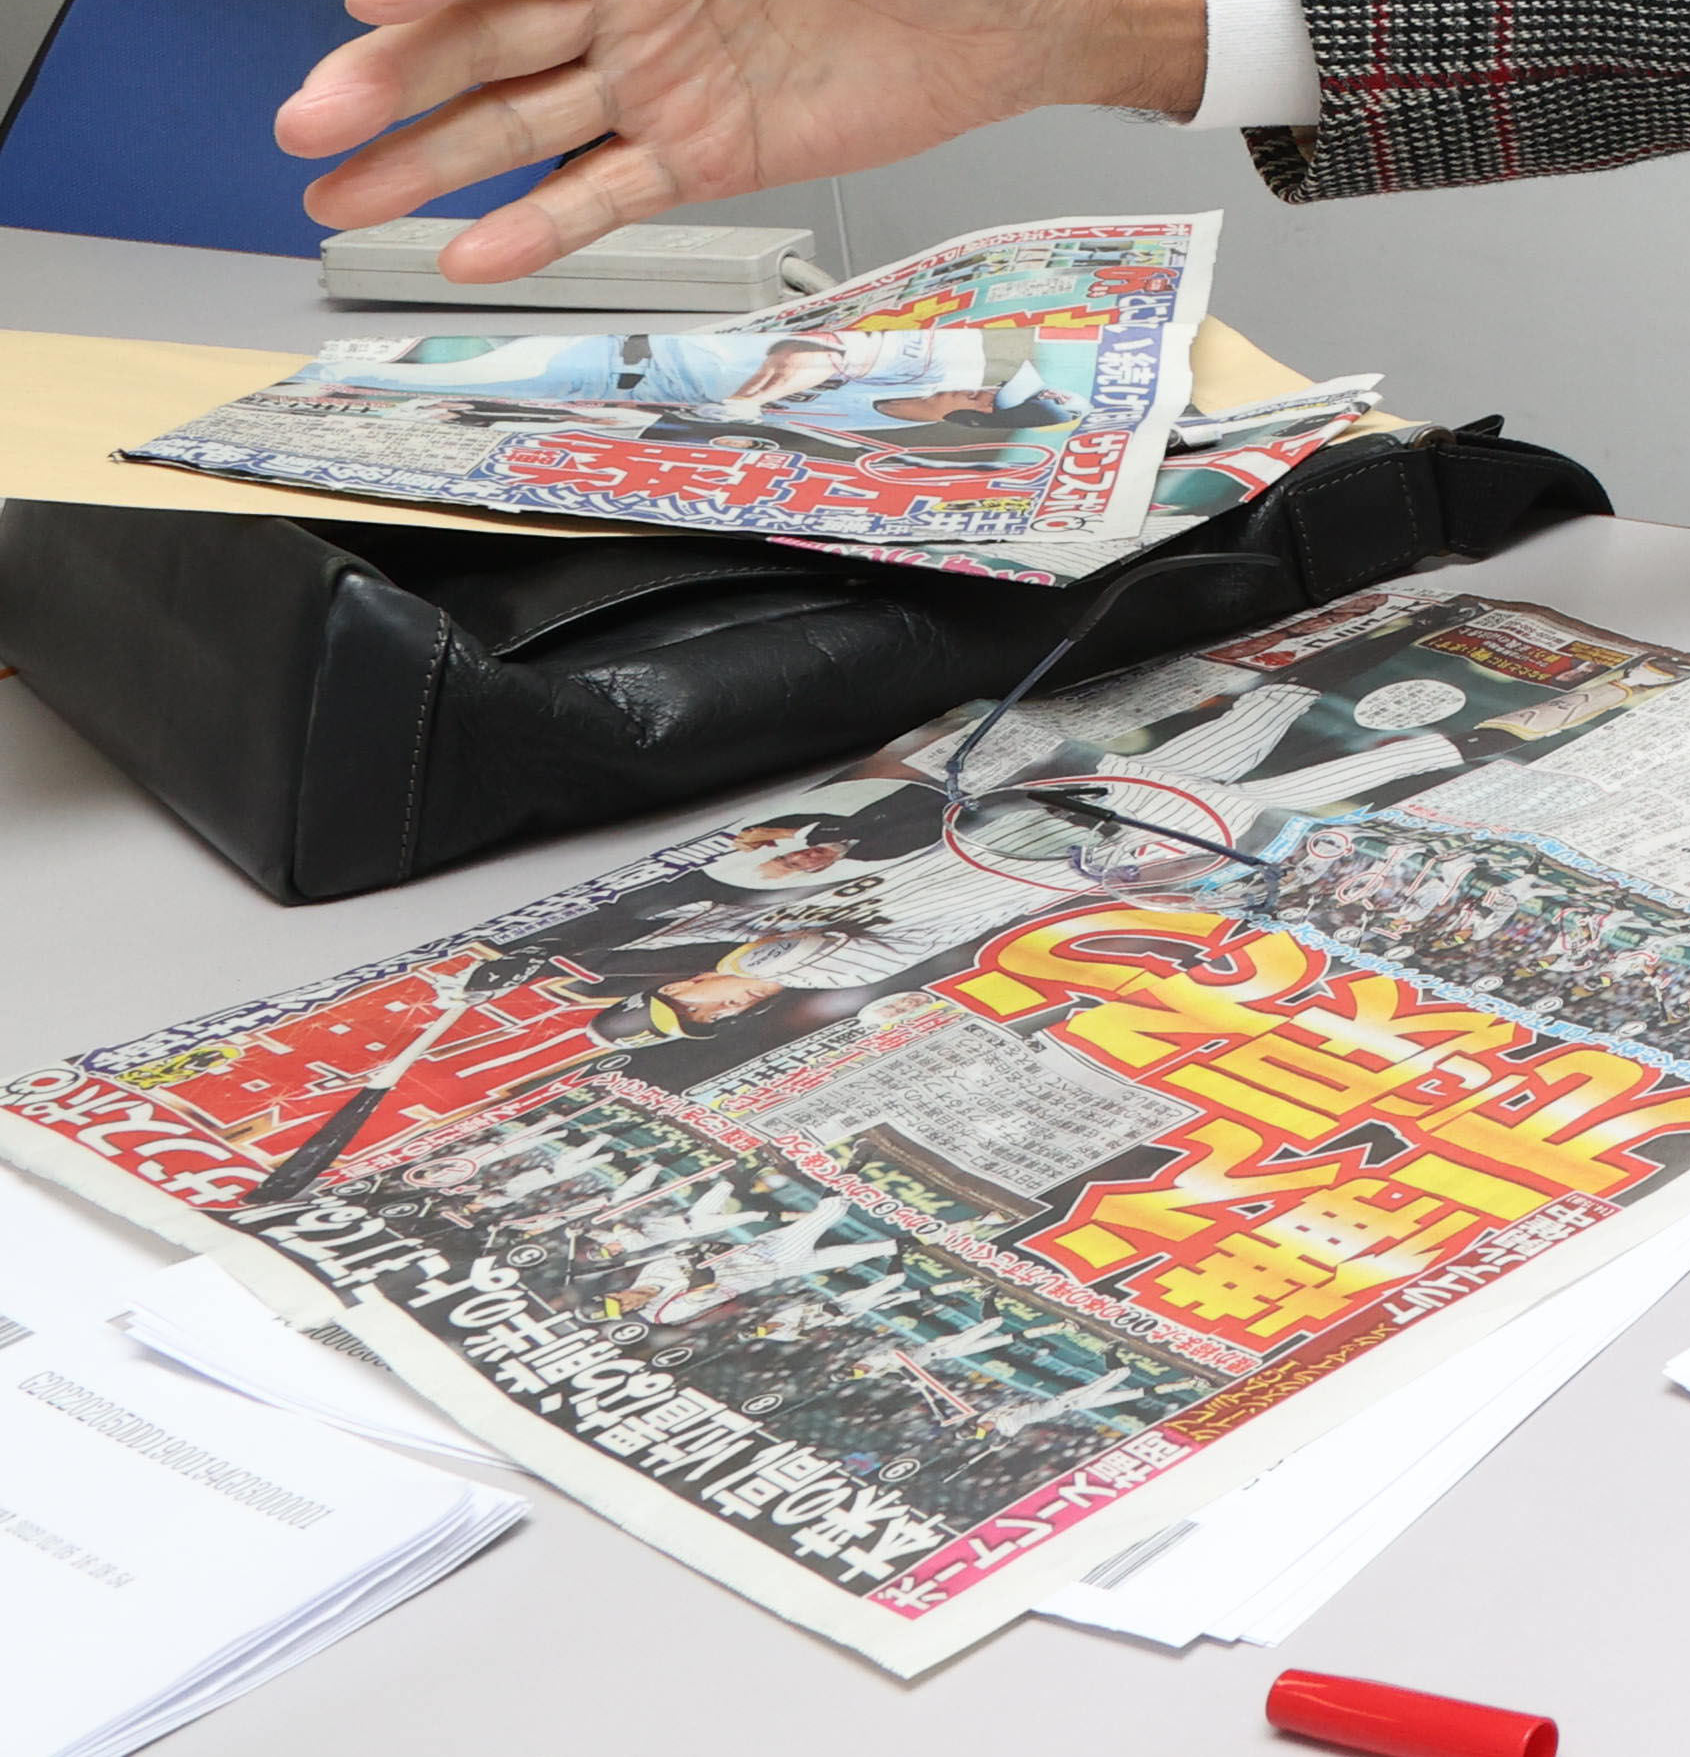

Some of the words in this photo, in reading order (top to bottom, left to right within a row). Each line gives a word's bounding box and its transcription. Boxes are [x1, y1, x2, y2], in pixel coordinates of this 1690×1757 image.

[1035, 431, 1130, 517] サンスポ
[716, 1007, 969, 1117] 虎戦士解析
[27, 1082, 275, 1209] サンスポ
[344, 1082, 570, 1177] 前半の打撃フォーム
[1007, 1113, 1497, 1351] 構え
[1375, 1201, 1599, 1324] トライアル開催中
[875, 1429, 1195, 1616] ボートレース福岡
